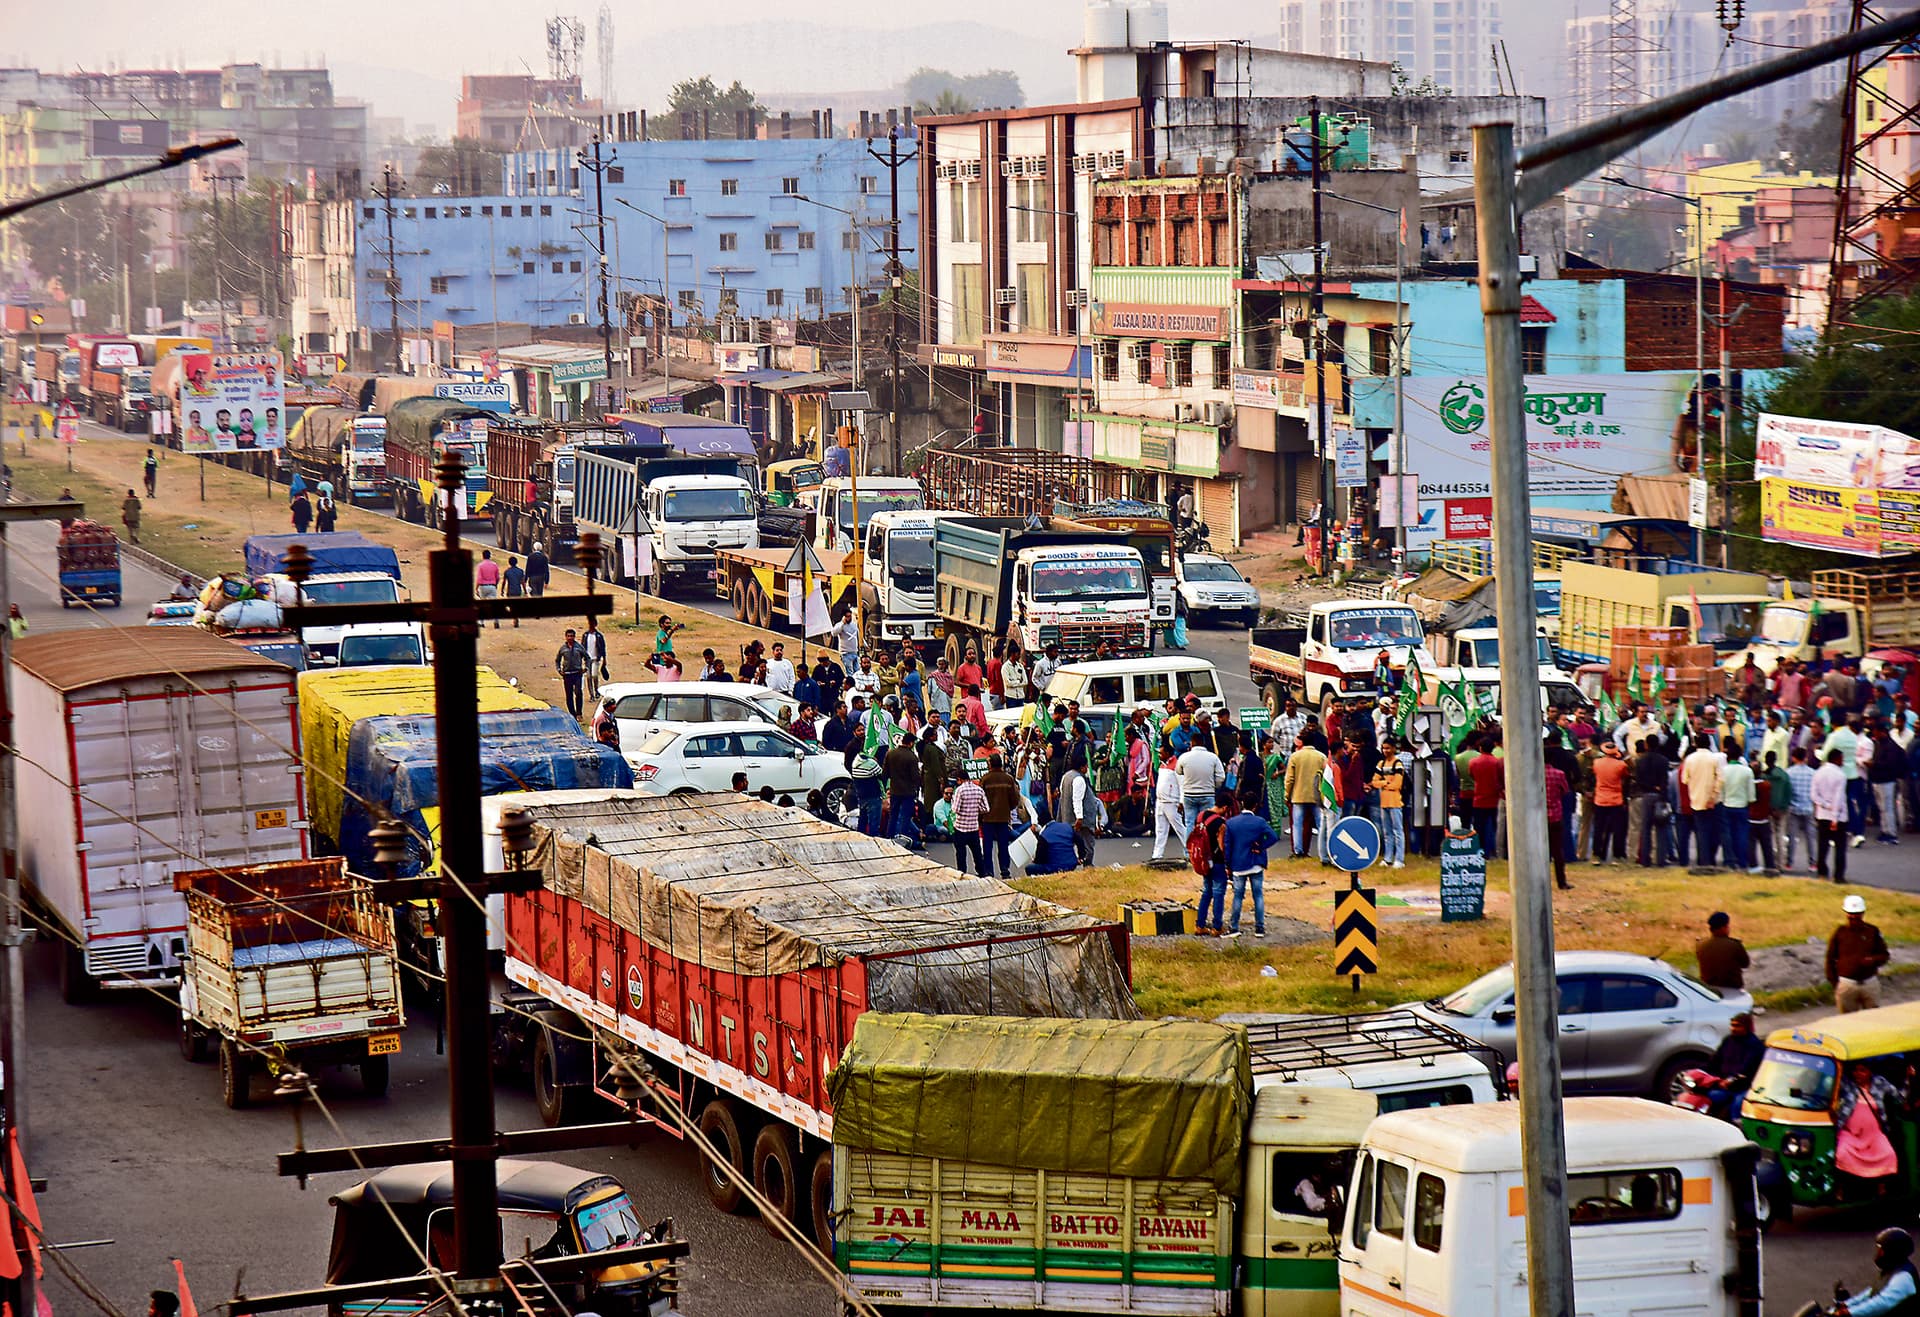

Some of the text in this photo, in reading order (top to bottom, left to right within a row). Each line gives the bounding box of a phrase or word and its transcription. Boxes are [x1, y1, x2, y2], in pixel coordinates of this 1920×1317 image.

[1113, 312, 1217, 333] JALSAA BAR & RESTAURANT
[1152, 356, 1164, 374] BAR
[453, 385, 505, 396] SAIZAR
[1523, 385, 1606, 425] ंकुरम
[1047, 552, 1078, 560] GOODS
[1342, 610, 1361, 618] JAI
[867, 1207, 1207, 1239] JAI MAA BATTO BAYANI
